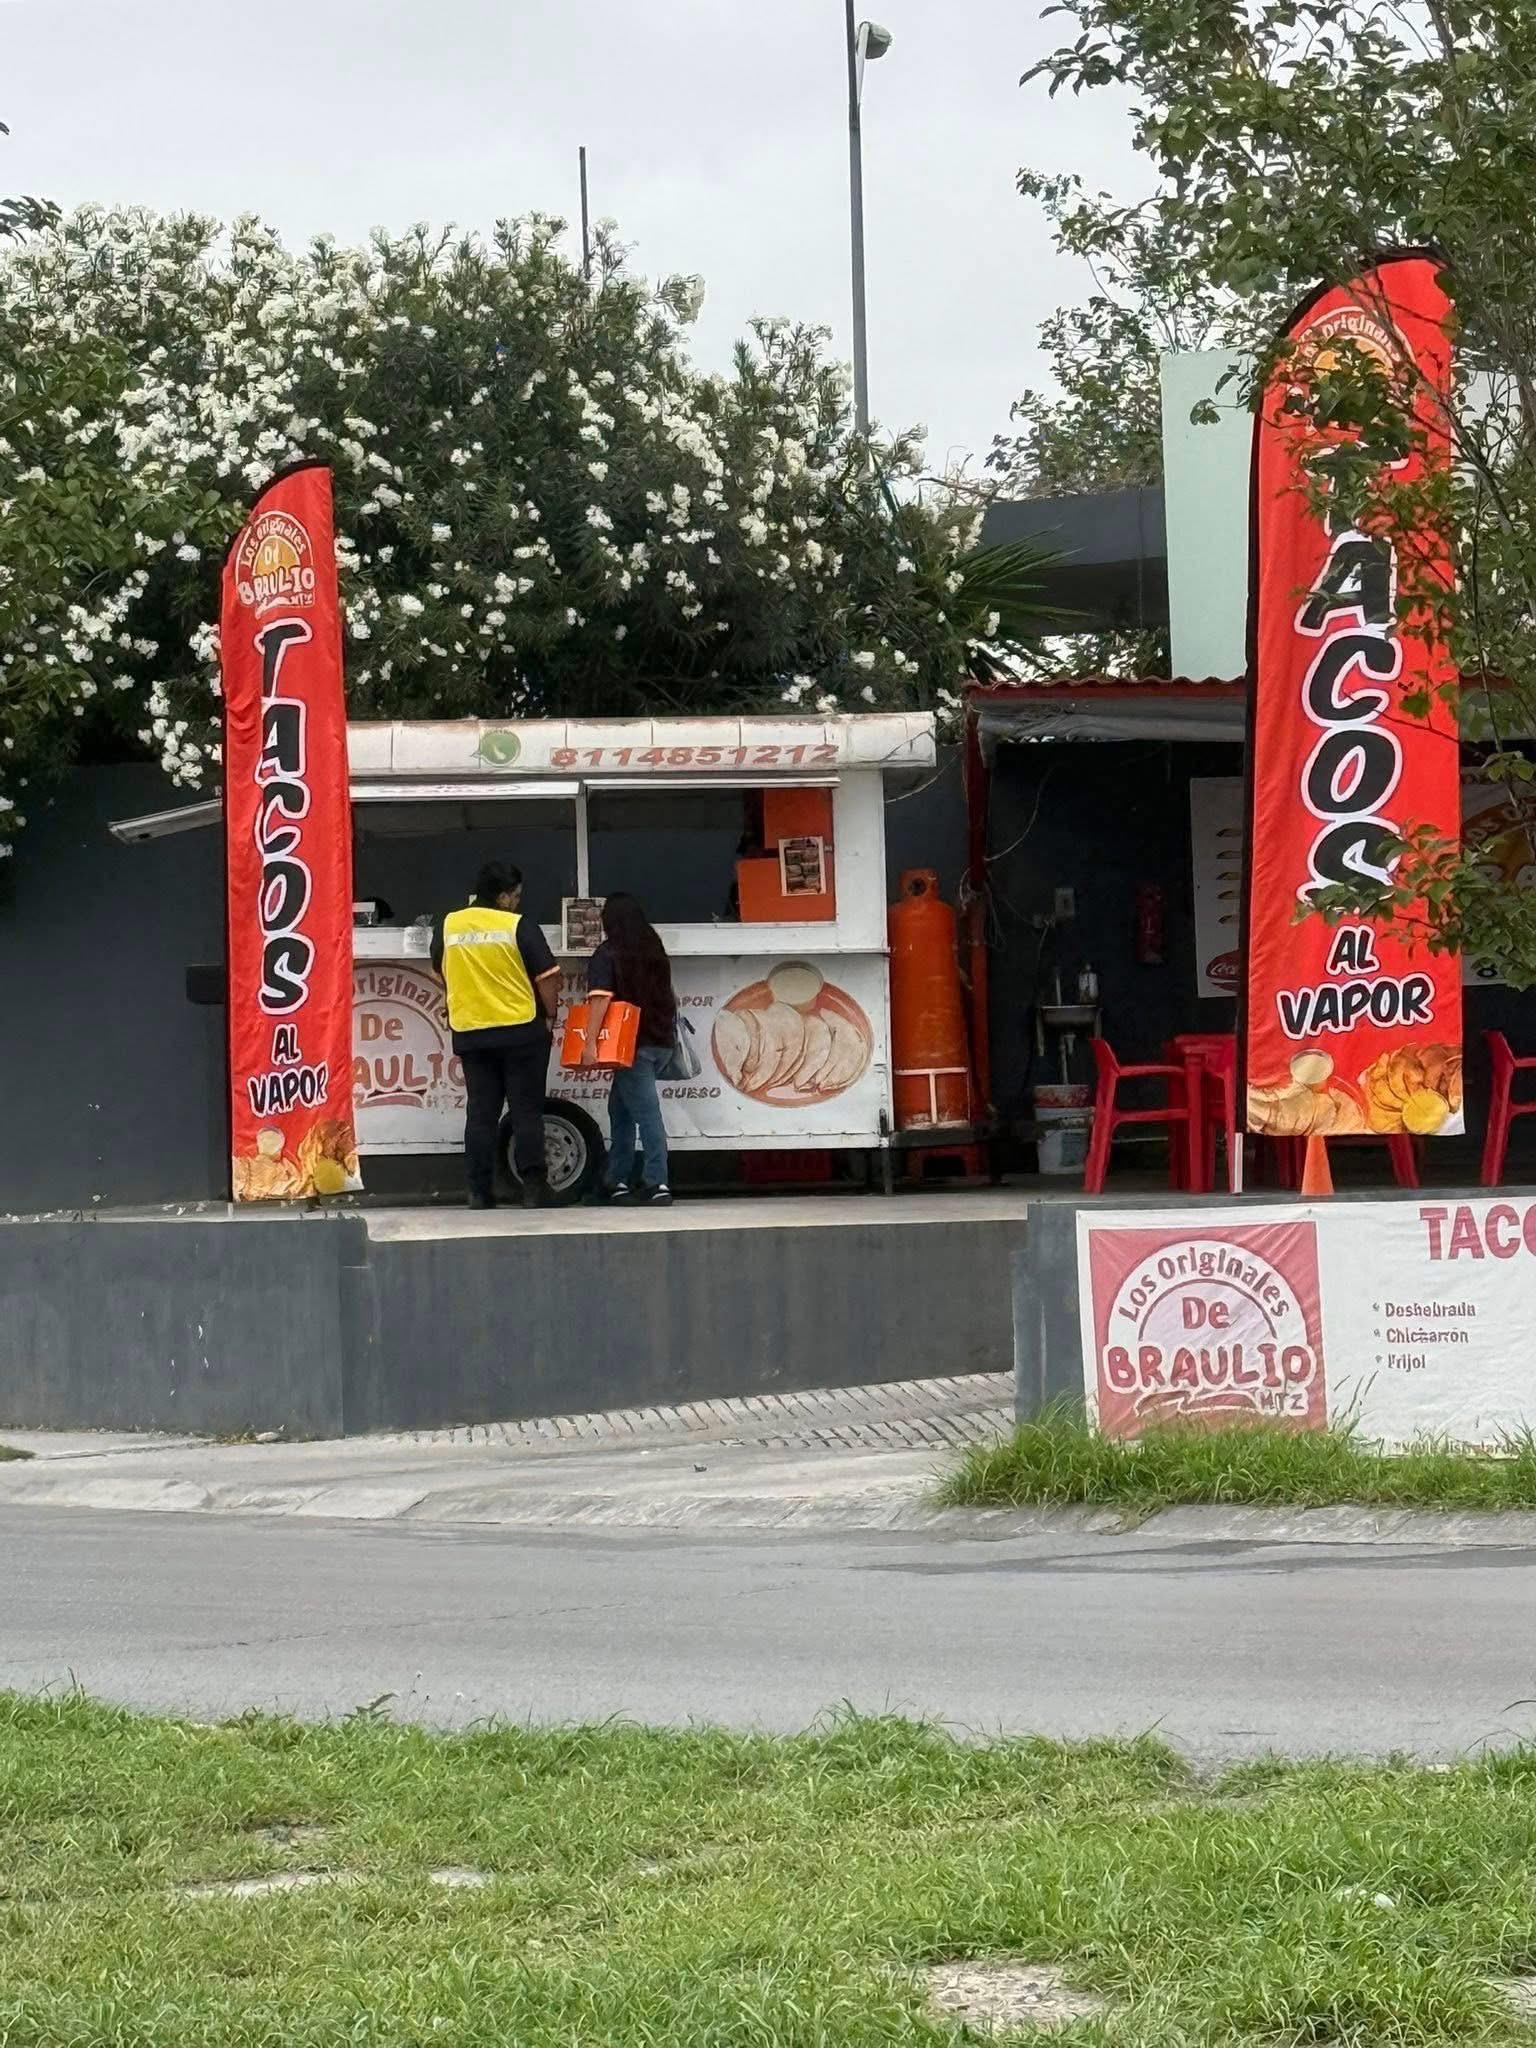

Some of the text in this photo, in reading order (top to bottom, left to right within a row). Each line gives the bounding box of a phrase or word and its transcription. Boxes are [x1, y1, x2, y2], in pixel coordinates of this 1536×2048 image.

[238, 565, 315, 606] BRAULIO
[550, 745, 839, 768] 8114851212
[254, 617, 315, 1016] TACOS
[1326, 924, 1380, 977] AL
[352, 972, 449, 1032] riginale
[1276, 972, 1436, 1040] VAPOR
[271, 1023, 303, 1067] AL
[360, 1013, 404, 1041] De
[247, 1061, 330, 1119] VAPOR
[353, 1052, 466, 1091] AULIO
[1119, 1247, 1290, 1323] Los Originales
[1182, 1296, 1231, 1330] De
[1385, 1301, 1477, 1318] Deshebrada
[1107, 1342, 1312, 1389] BRAULIO
[1387, 1354, 1427, 1373] Frijol
